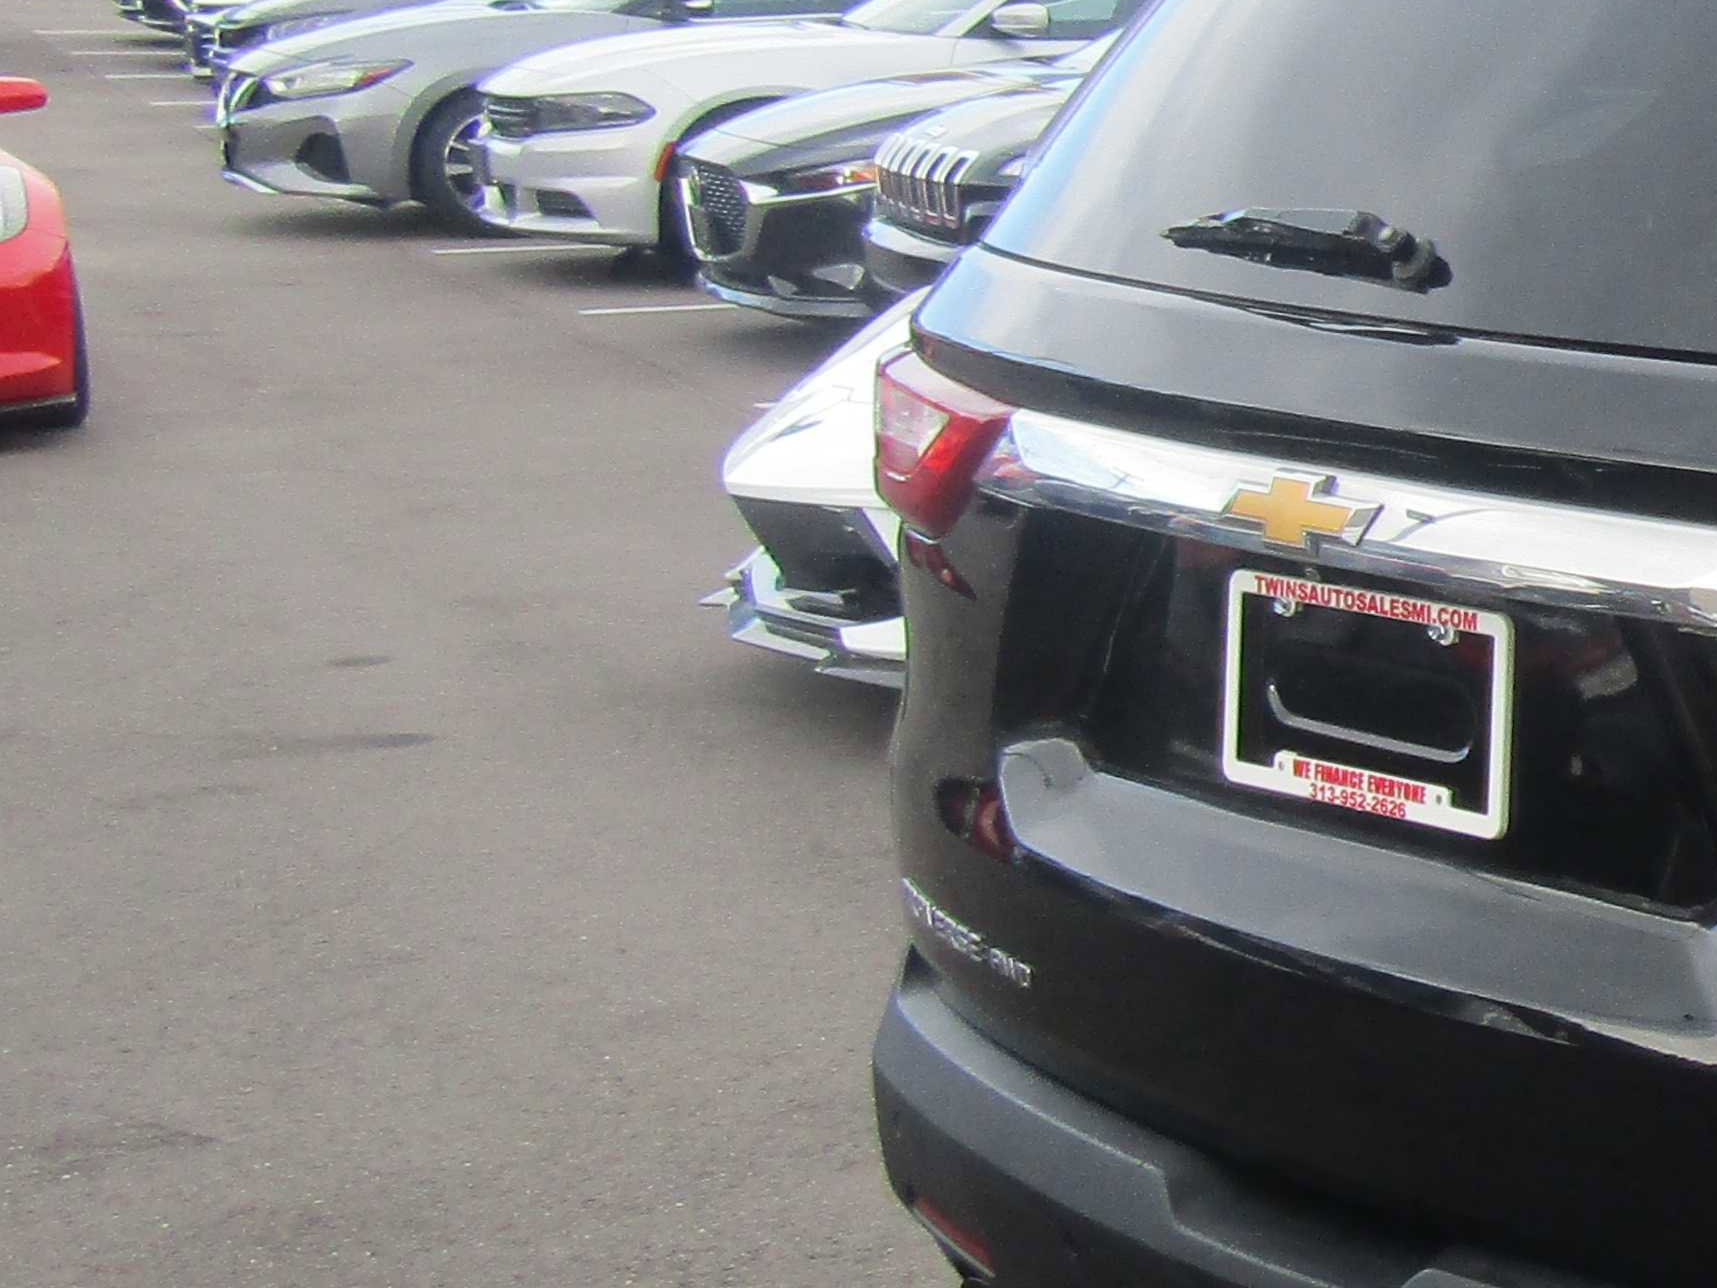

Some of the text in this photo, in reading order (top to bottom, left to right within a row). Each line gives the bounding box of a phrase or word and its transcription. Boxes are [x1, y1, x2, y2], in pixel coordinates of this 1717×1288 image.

[1254, 575, 1478, 631] TWINSAUTOSALESMI.COM
[1293, 759, 1427, 804] WE FINANCE EVERYONE
[1310, 783, 1407, 818] 313-952-2626
